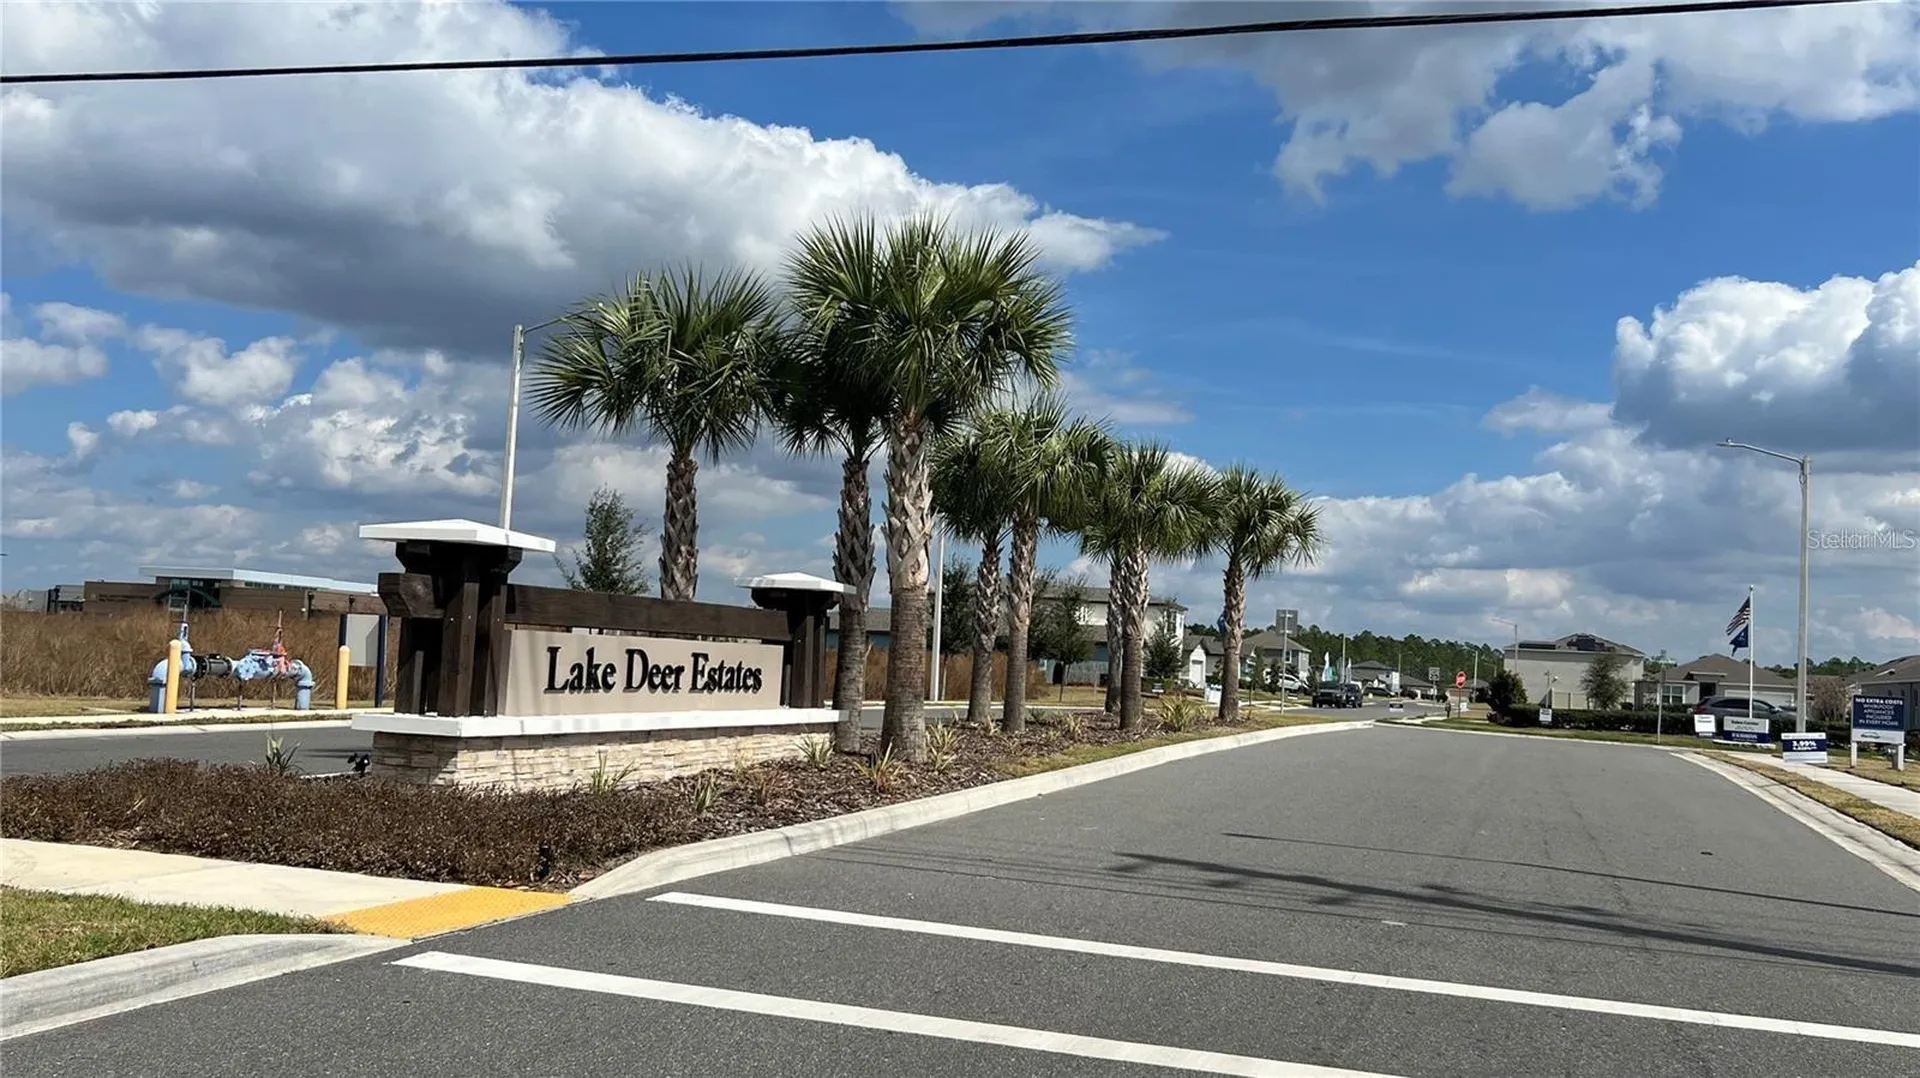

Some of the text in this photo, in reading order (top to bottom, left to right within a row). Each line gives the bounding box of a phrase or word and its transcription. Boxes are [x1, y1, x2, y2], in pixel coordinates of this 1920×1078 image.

[544, 646, 762, 694] Lake Deer Estates
